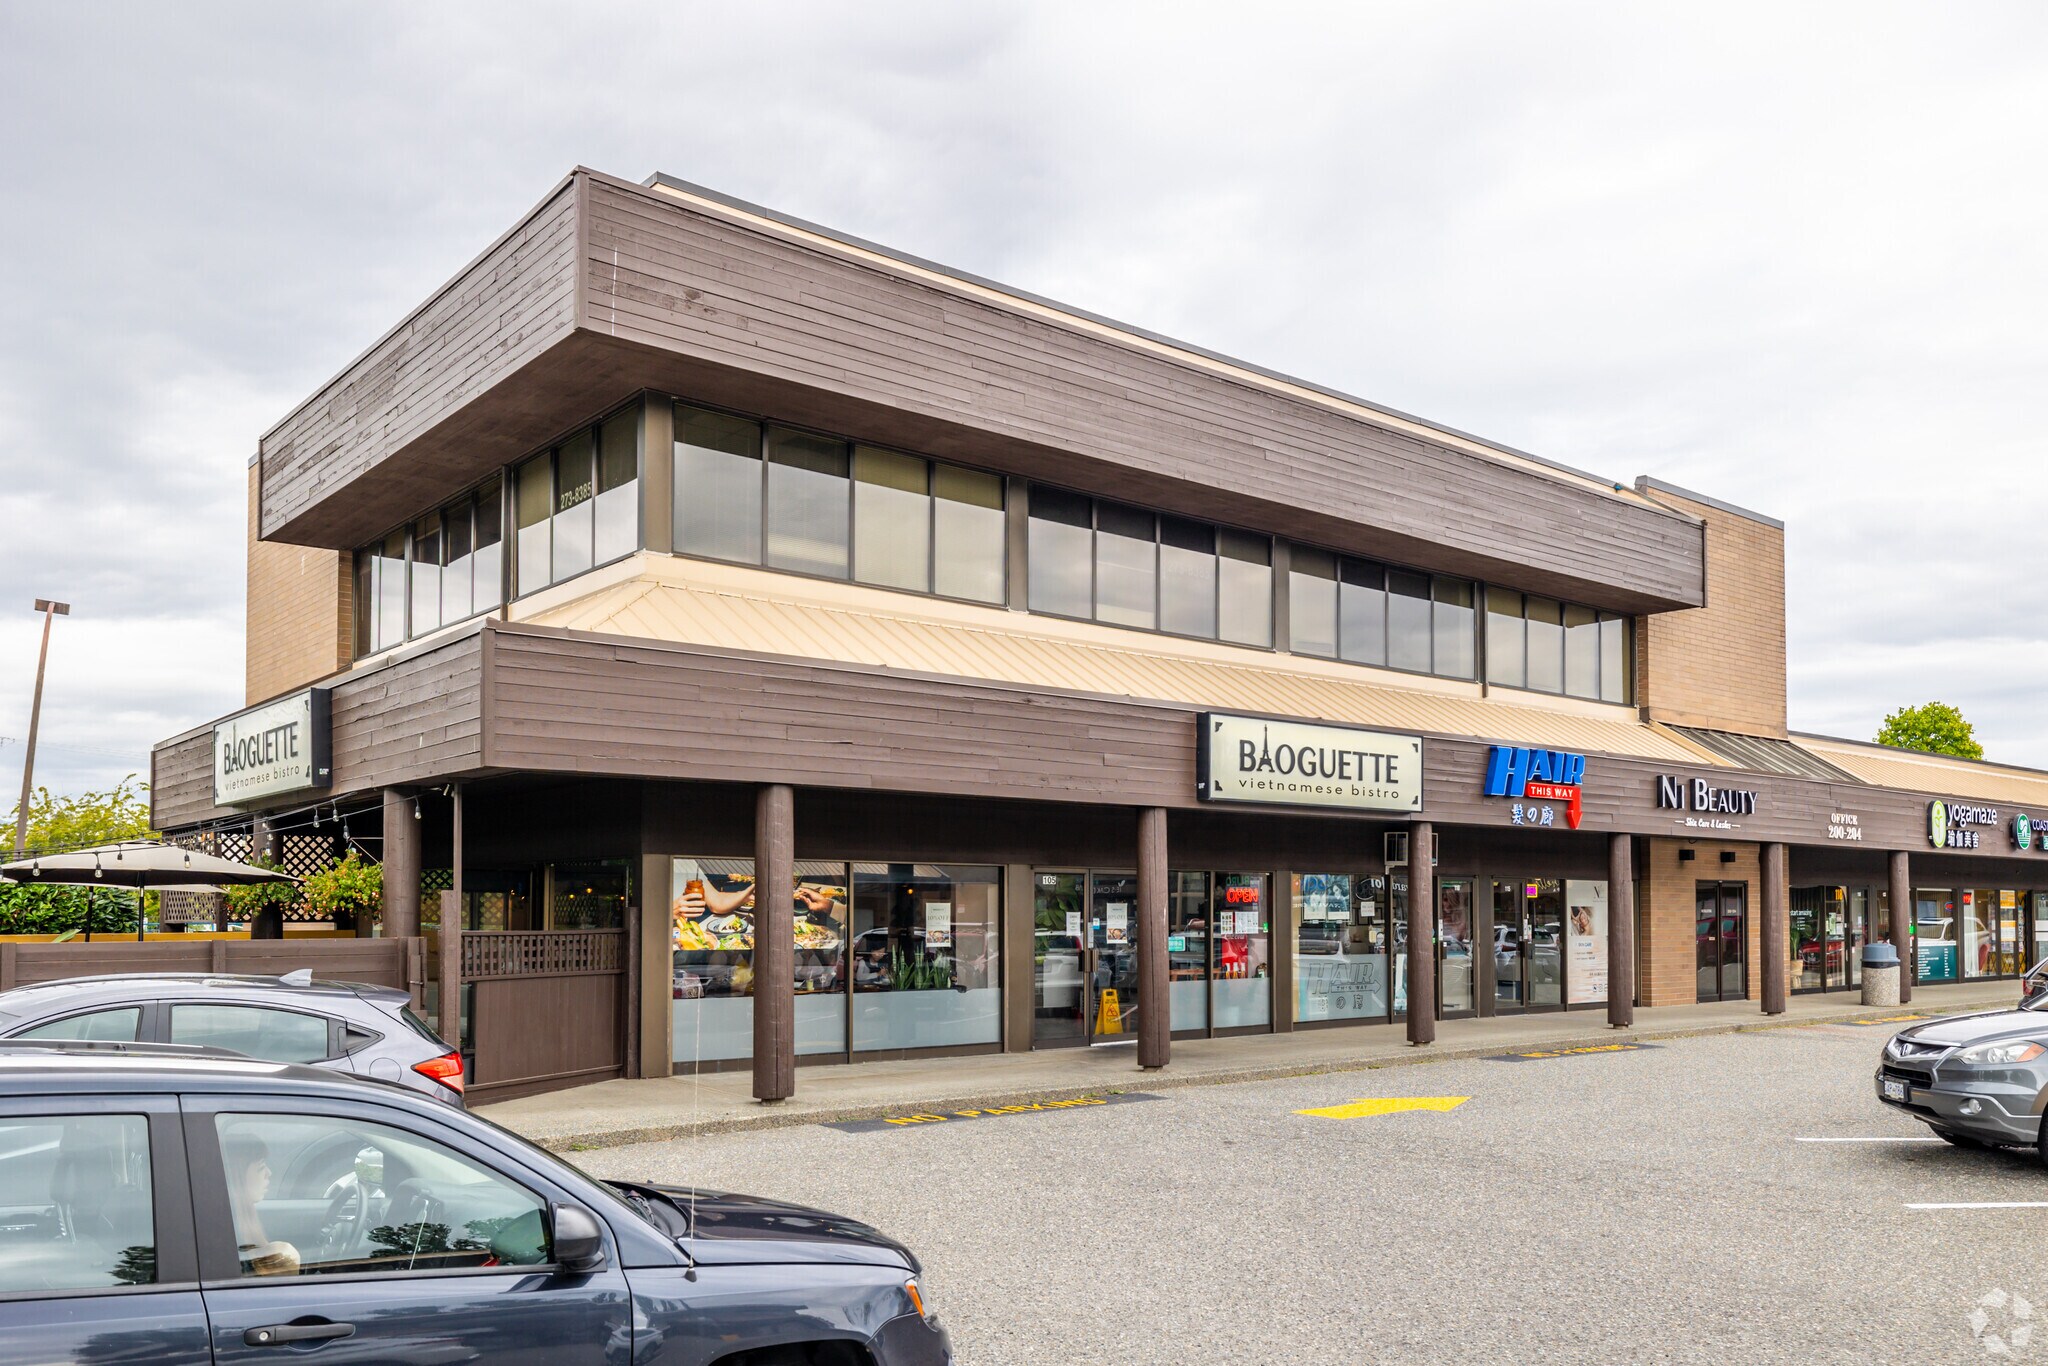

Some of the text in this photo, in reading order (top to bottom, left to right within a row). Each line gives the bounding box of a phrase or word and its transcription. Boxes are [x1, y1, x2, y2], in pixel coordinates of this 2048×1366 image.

[560, 481, 592, 510] 273-8385
[223, 721, 299, 775] BAOGUETTE
[1239, 723, 1399, 784] BAOGUETTE
[224, 765, 300, 791] vietnamese bistro
[1485, 746, 1586, 798] HAIR
[1238, 777, 1399, 799] vietnamese bistro
[1530, 786, 1574, 798] THIS WAY
[1830, 812, 1858, 825] OFFICE
[1947, 803, 1998, 828] yogamaze
[1828, 825, 1862, 840] 200-204
[1043, 875, 1057, 885] 105
[1226, 887, 1259, 903] OPEN
[1306, 962, 1374, 995] HAIR
[883, 1098, 1108, 1126] NO PARKING
